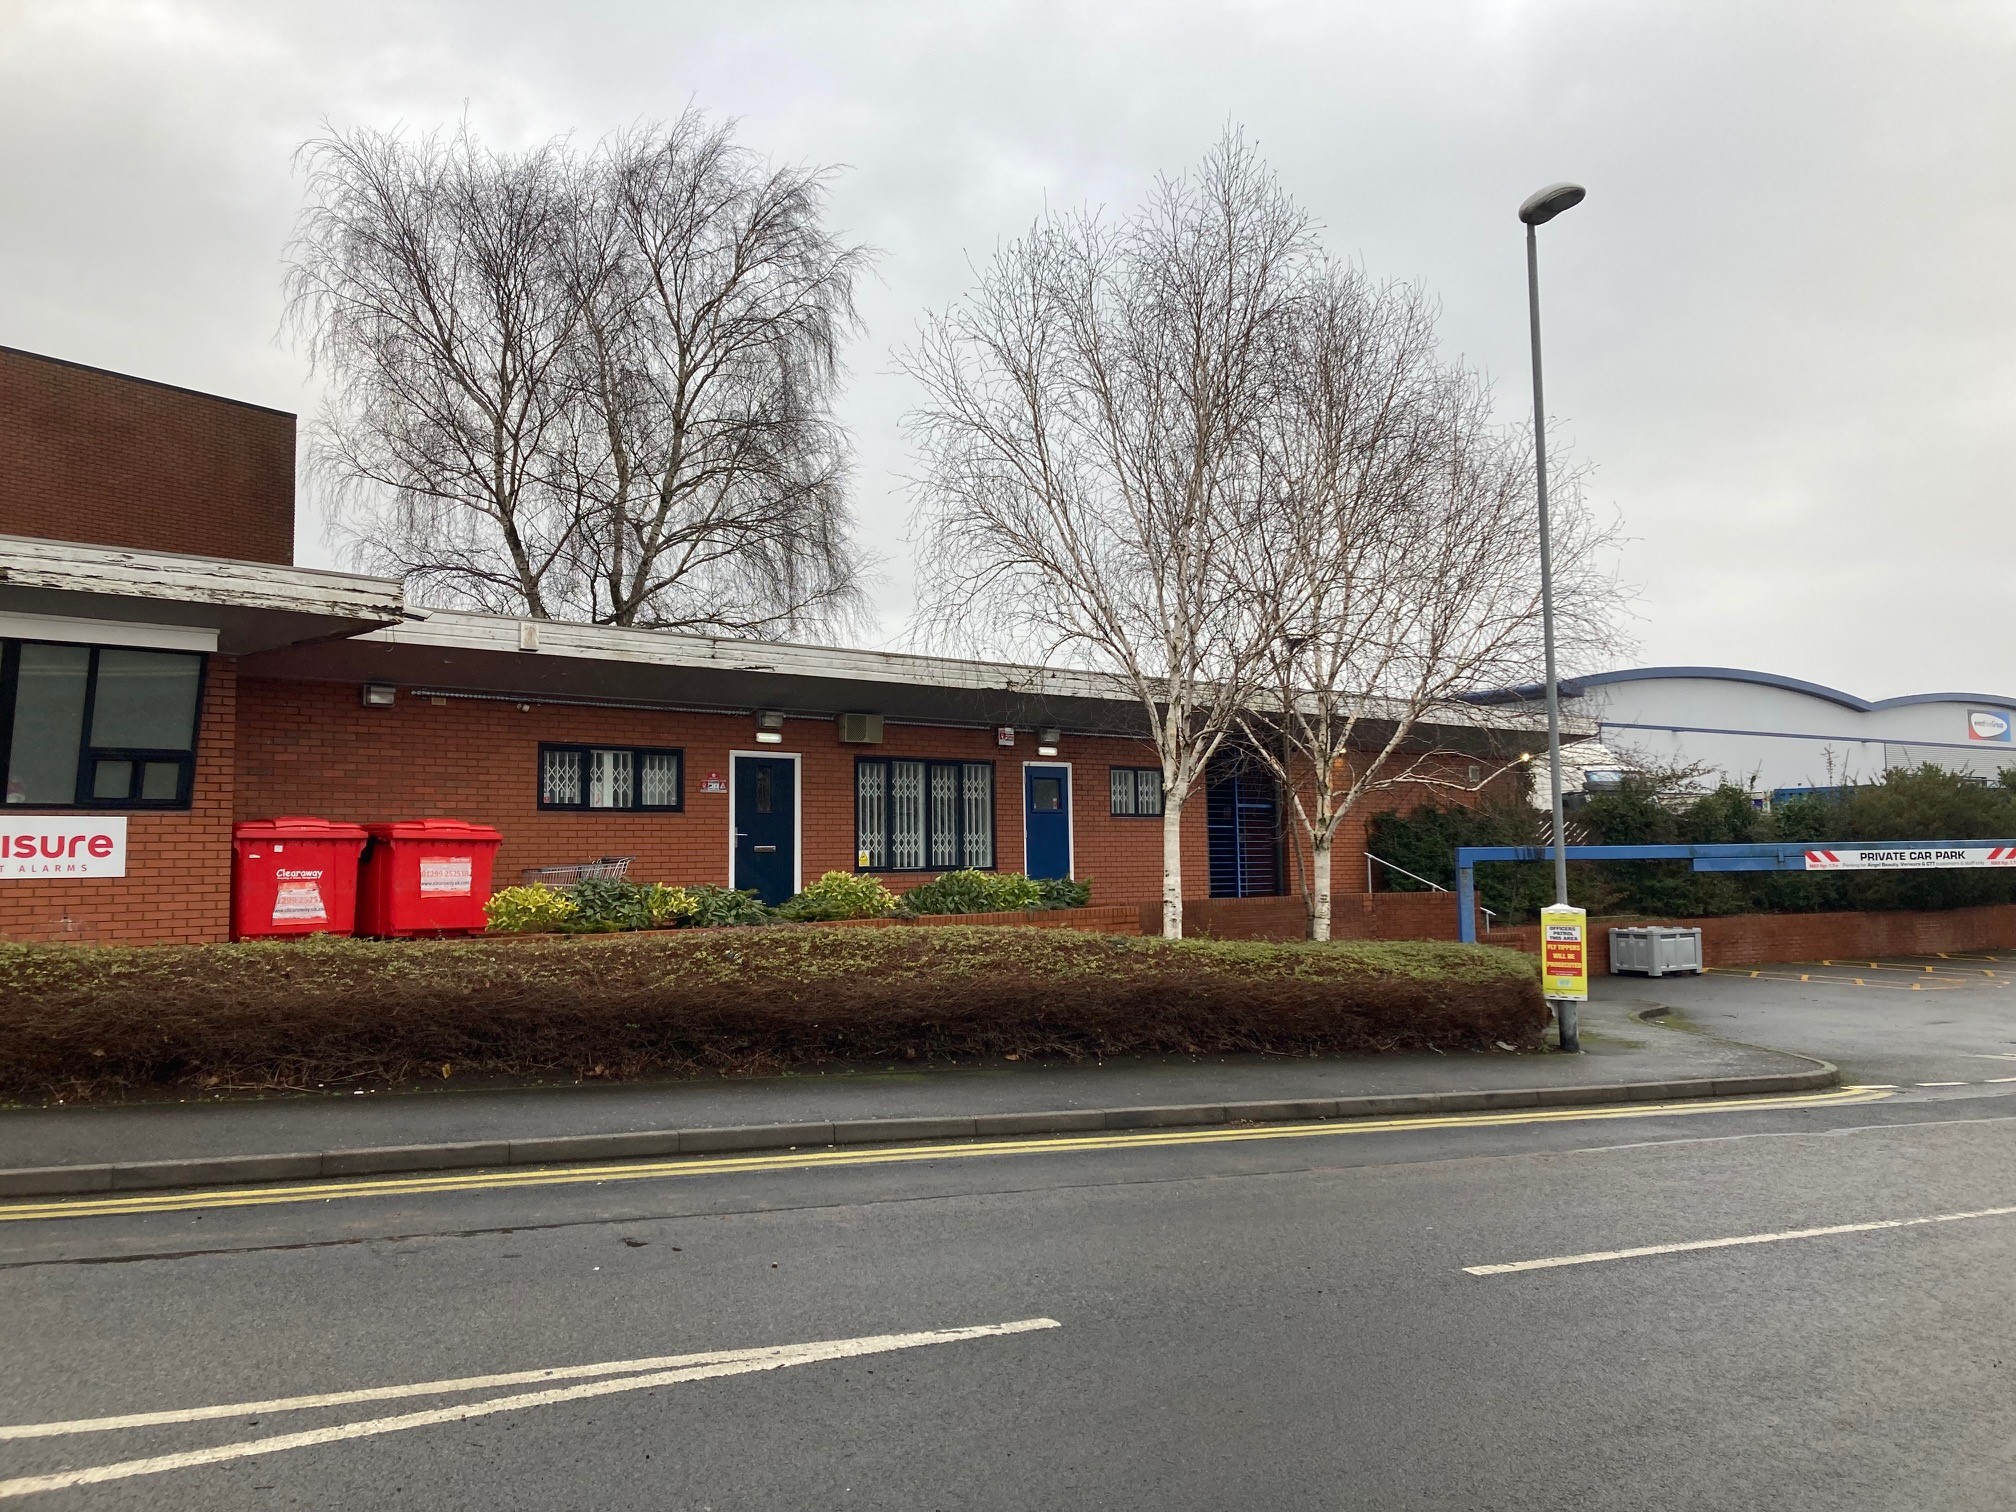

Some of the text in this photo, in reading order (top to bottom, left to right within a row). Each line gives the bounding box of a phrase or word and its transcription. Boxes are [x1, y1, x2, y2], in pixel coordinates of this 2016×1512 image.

[1860, 851, 1965, 860] PRIVATE CAR PARK
[19, 864, 87, 872] ALARMS
[276, 869, 323, 879] Clearaway
